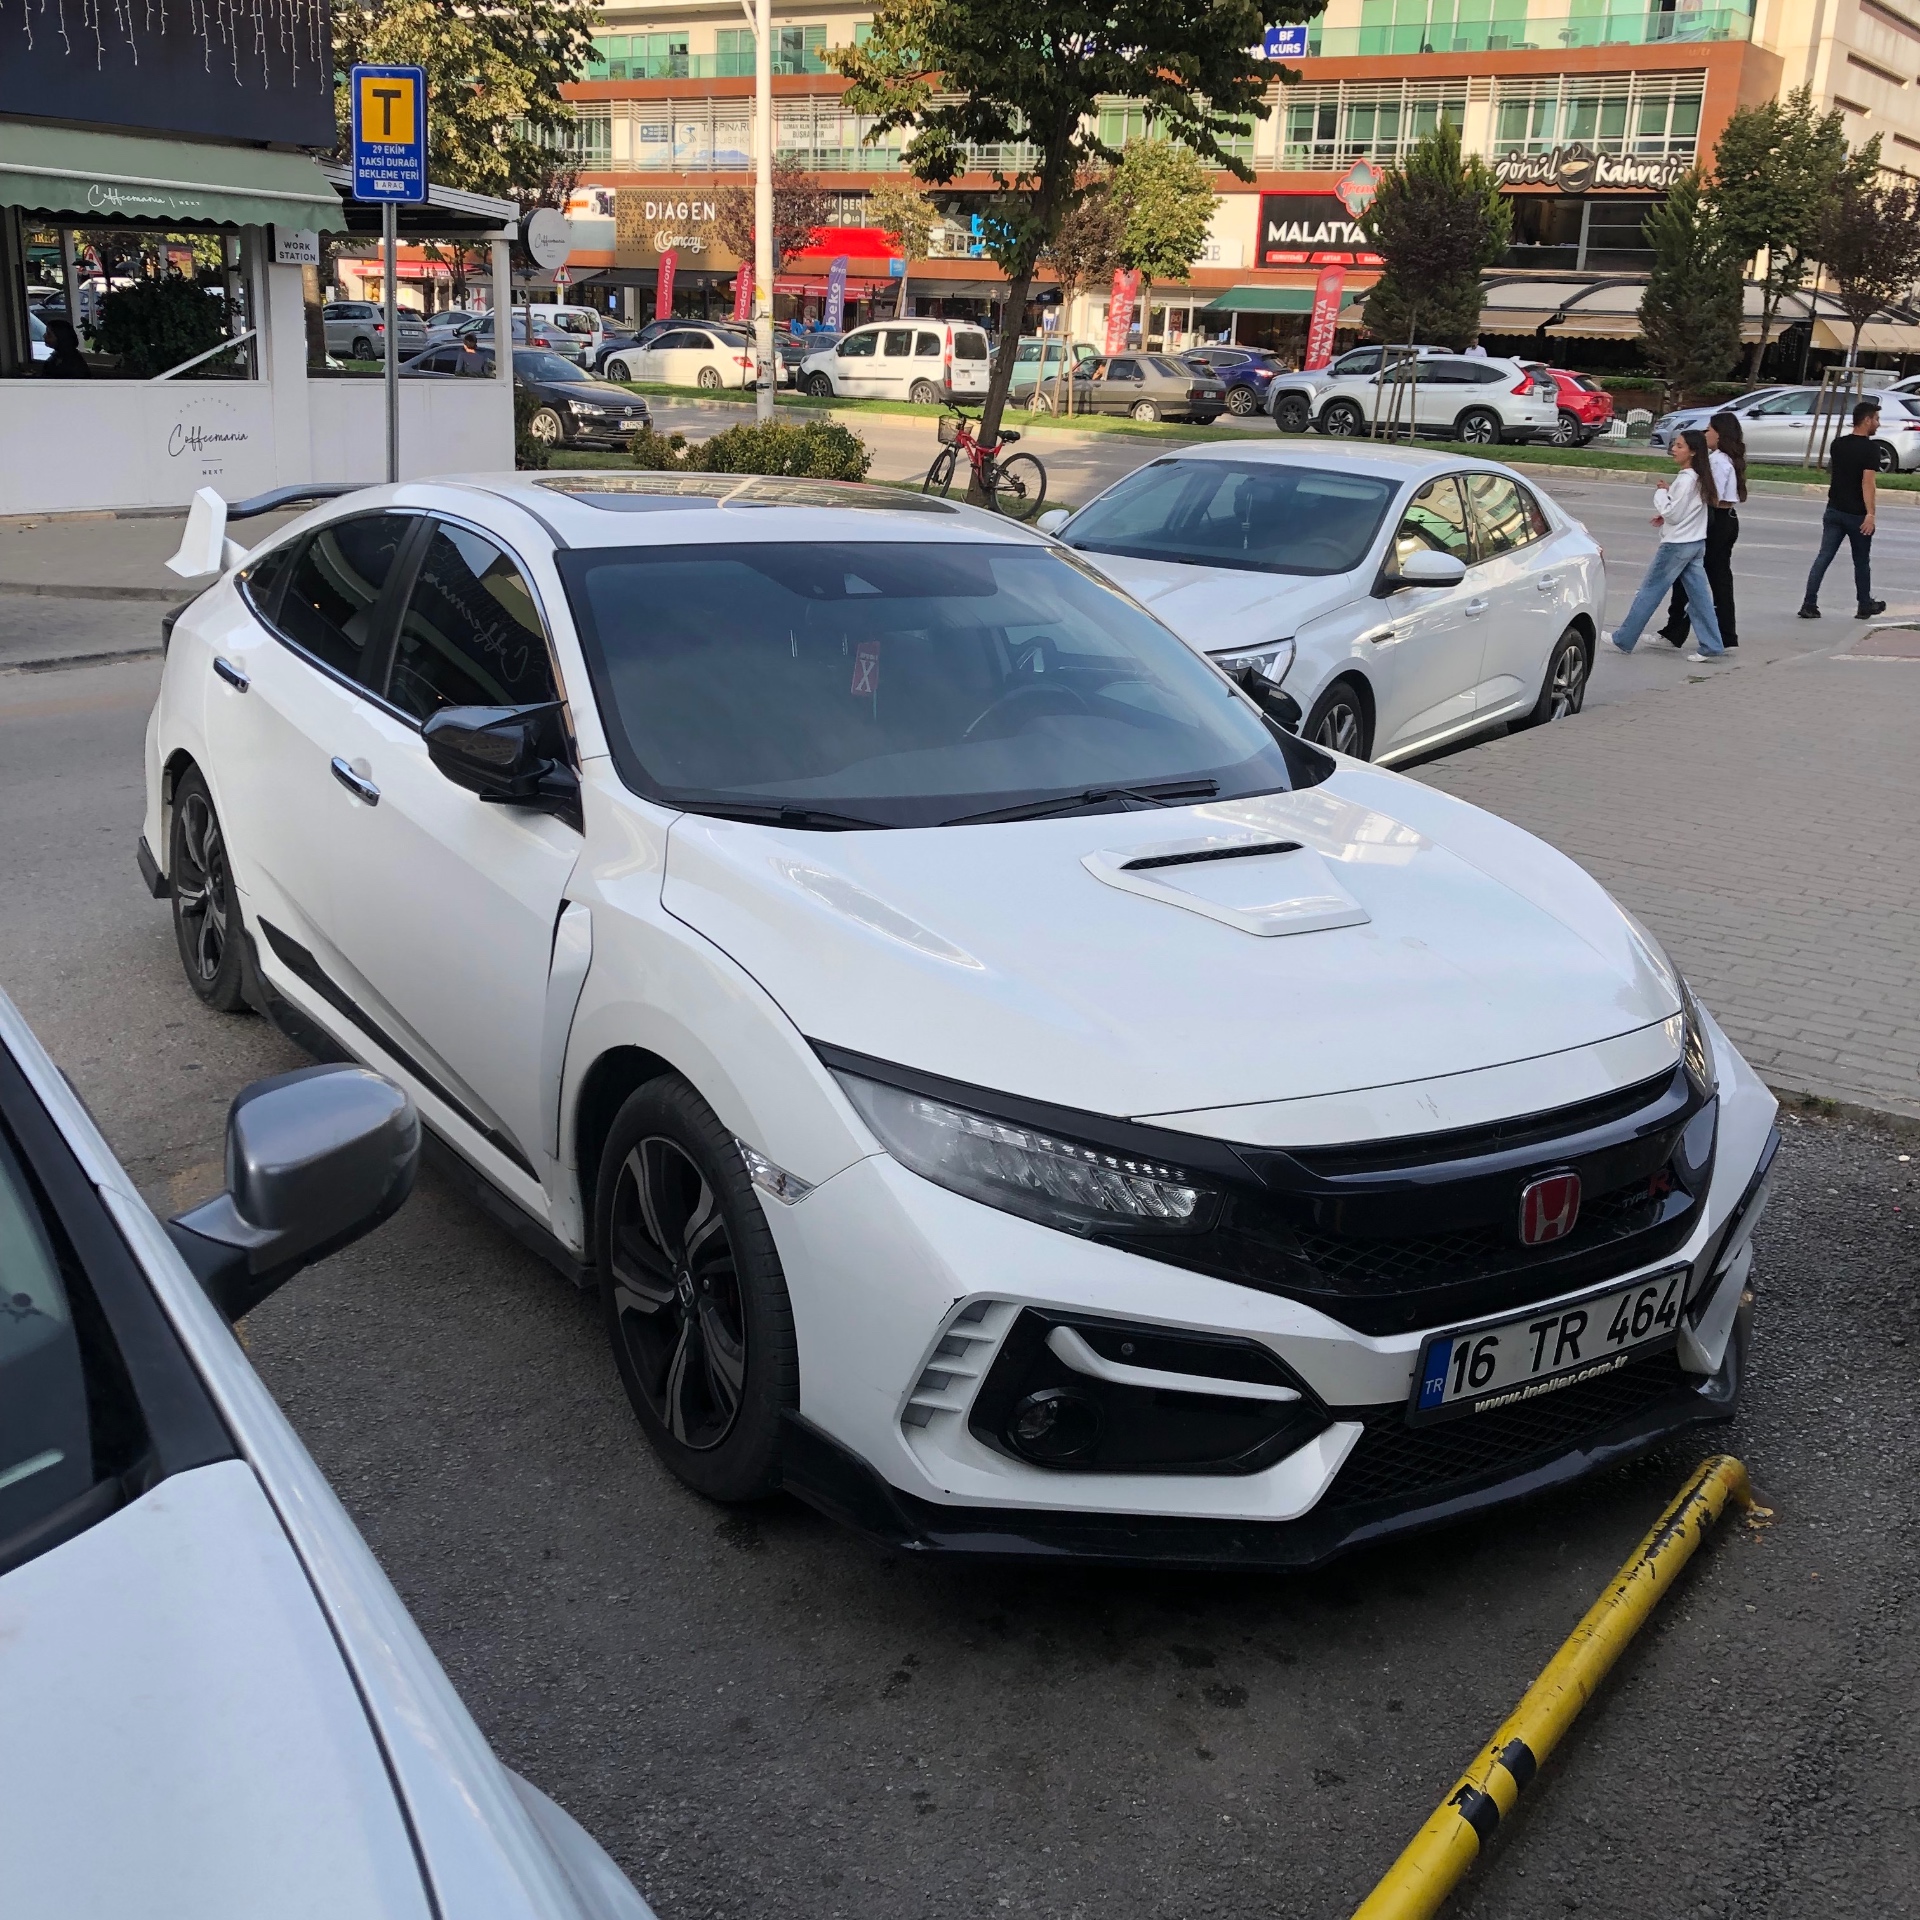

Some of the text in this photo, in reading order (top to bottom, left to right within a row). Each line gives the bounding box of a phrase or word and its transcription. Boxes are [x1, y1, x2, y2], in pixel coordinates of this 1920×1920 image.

[1279, 31, 1294, 41] BF
[1270, 43, 1301, 54] KURS
[372, 89, 402, 136] T
[372, 144, 405, 155] 29 EKİM
[360, 157, 417, 168] TAKSİ DURAĞI
[359, 169, 419, 180] BEKLEME YERİ
[645, 201, 715, 222] DIAGEN
[1268, 221, 1367, 243] MALATYA
[284, 241, 311, 250] WORK
[279, 250, 316, 261] STATION
[1308, 299, 1328, 362] MALATYA
[1320, 307, 1338, 356] PAZARI
[168, 423, 248, 457] Coffeemania
[1451, 1278, 1679, 1394] 16 TR 464
[1425, 1378, 1443, 1395] TR
